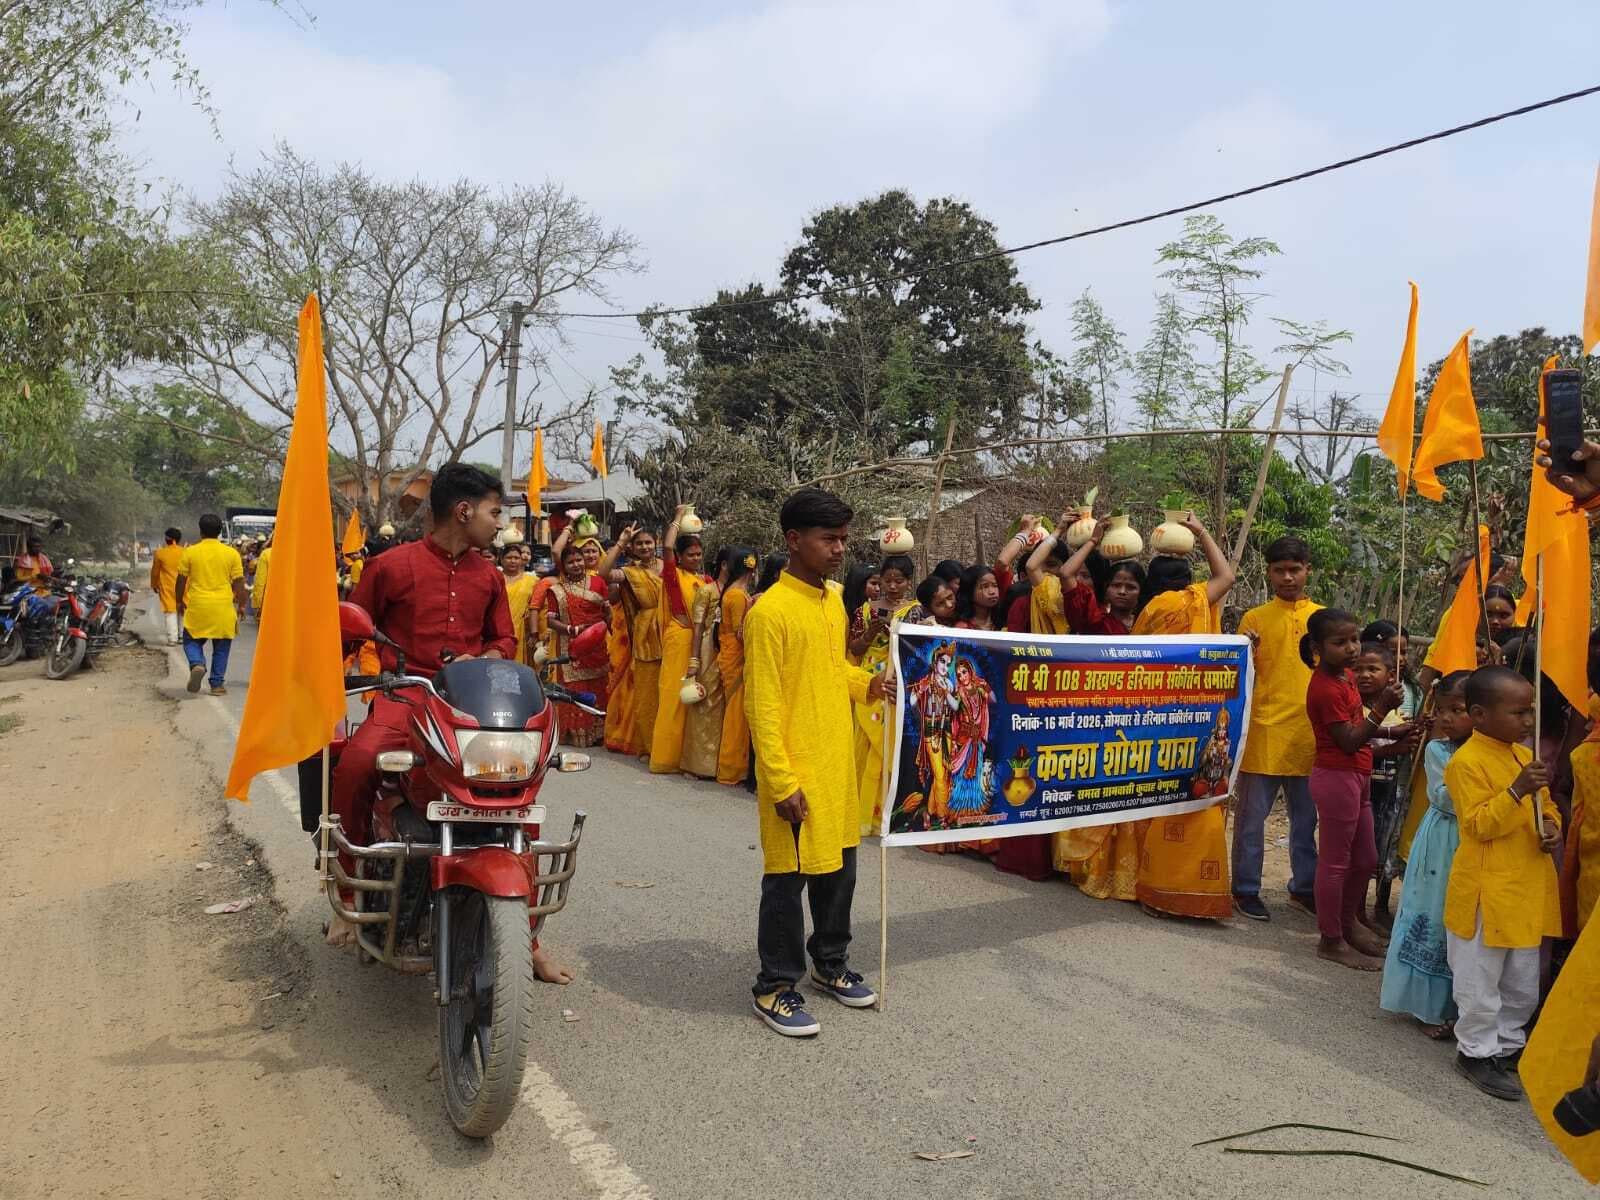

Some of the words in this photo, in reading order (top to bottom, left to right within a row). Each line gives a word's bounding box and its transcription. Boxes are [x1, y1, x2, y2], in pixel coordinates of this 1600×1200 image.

[1012, 663, 1030, 691] श्री
[1032, 664, 1050, 691] श्री
[1054, 670, 1080, 691] 108
[1084, 670, 1125, 691] अखण्ड
[1127, 665, 1165, 690] हरिनाम
[1203, 665, 1237, 689] समारोह
[1058, 712, 1076, 729] मार्च
[1133, 710, 1140, 726] से
[1142, 710, 1167, 726] हरिनाम
[1037, 743, 1100, 781] कलश
[1102, 729, 1154, 777] शोभा
[1157, 736, 1199, 771] यात्रा
[438, 806, 464, 817] जय
[472, 809, 502, 818] माता
